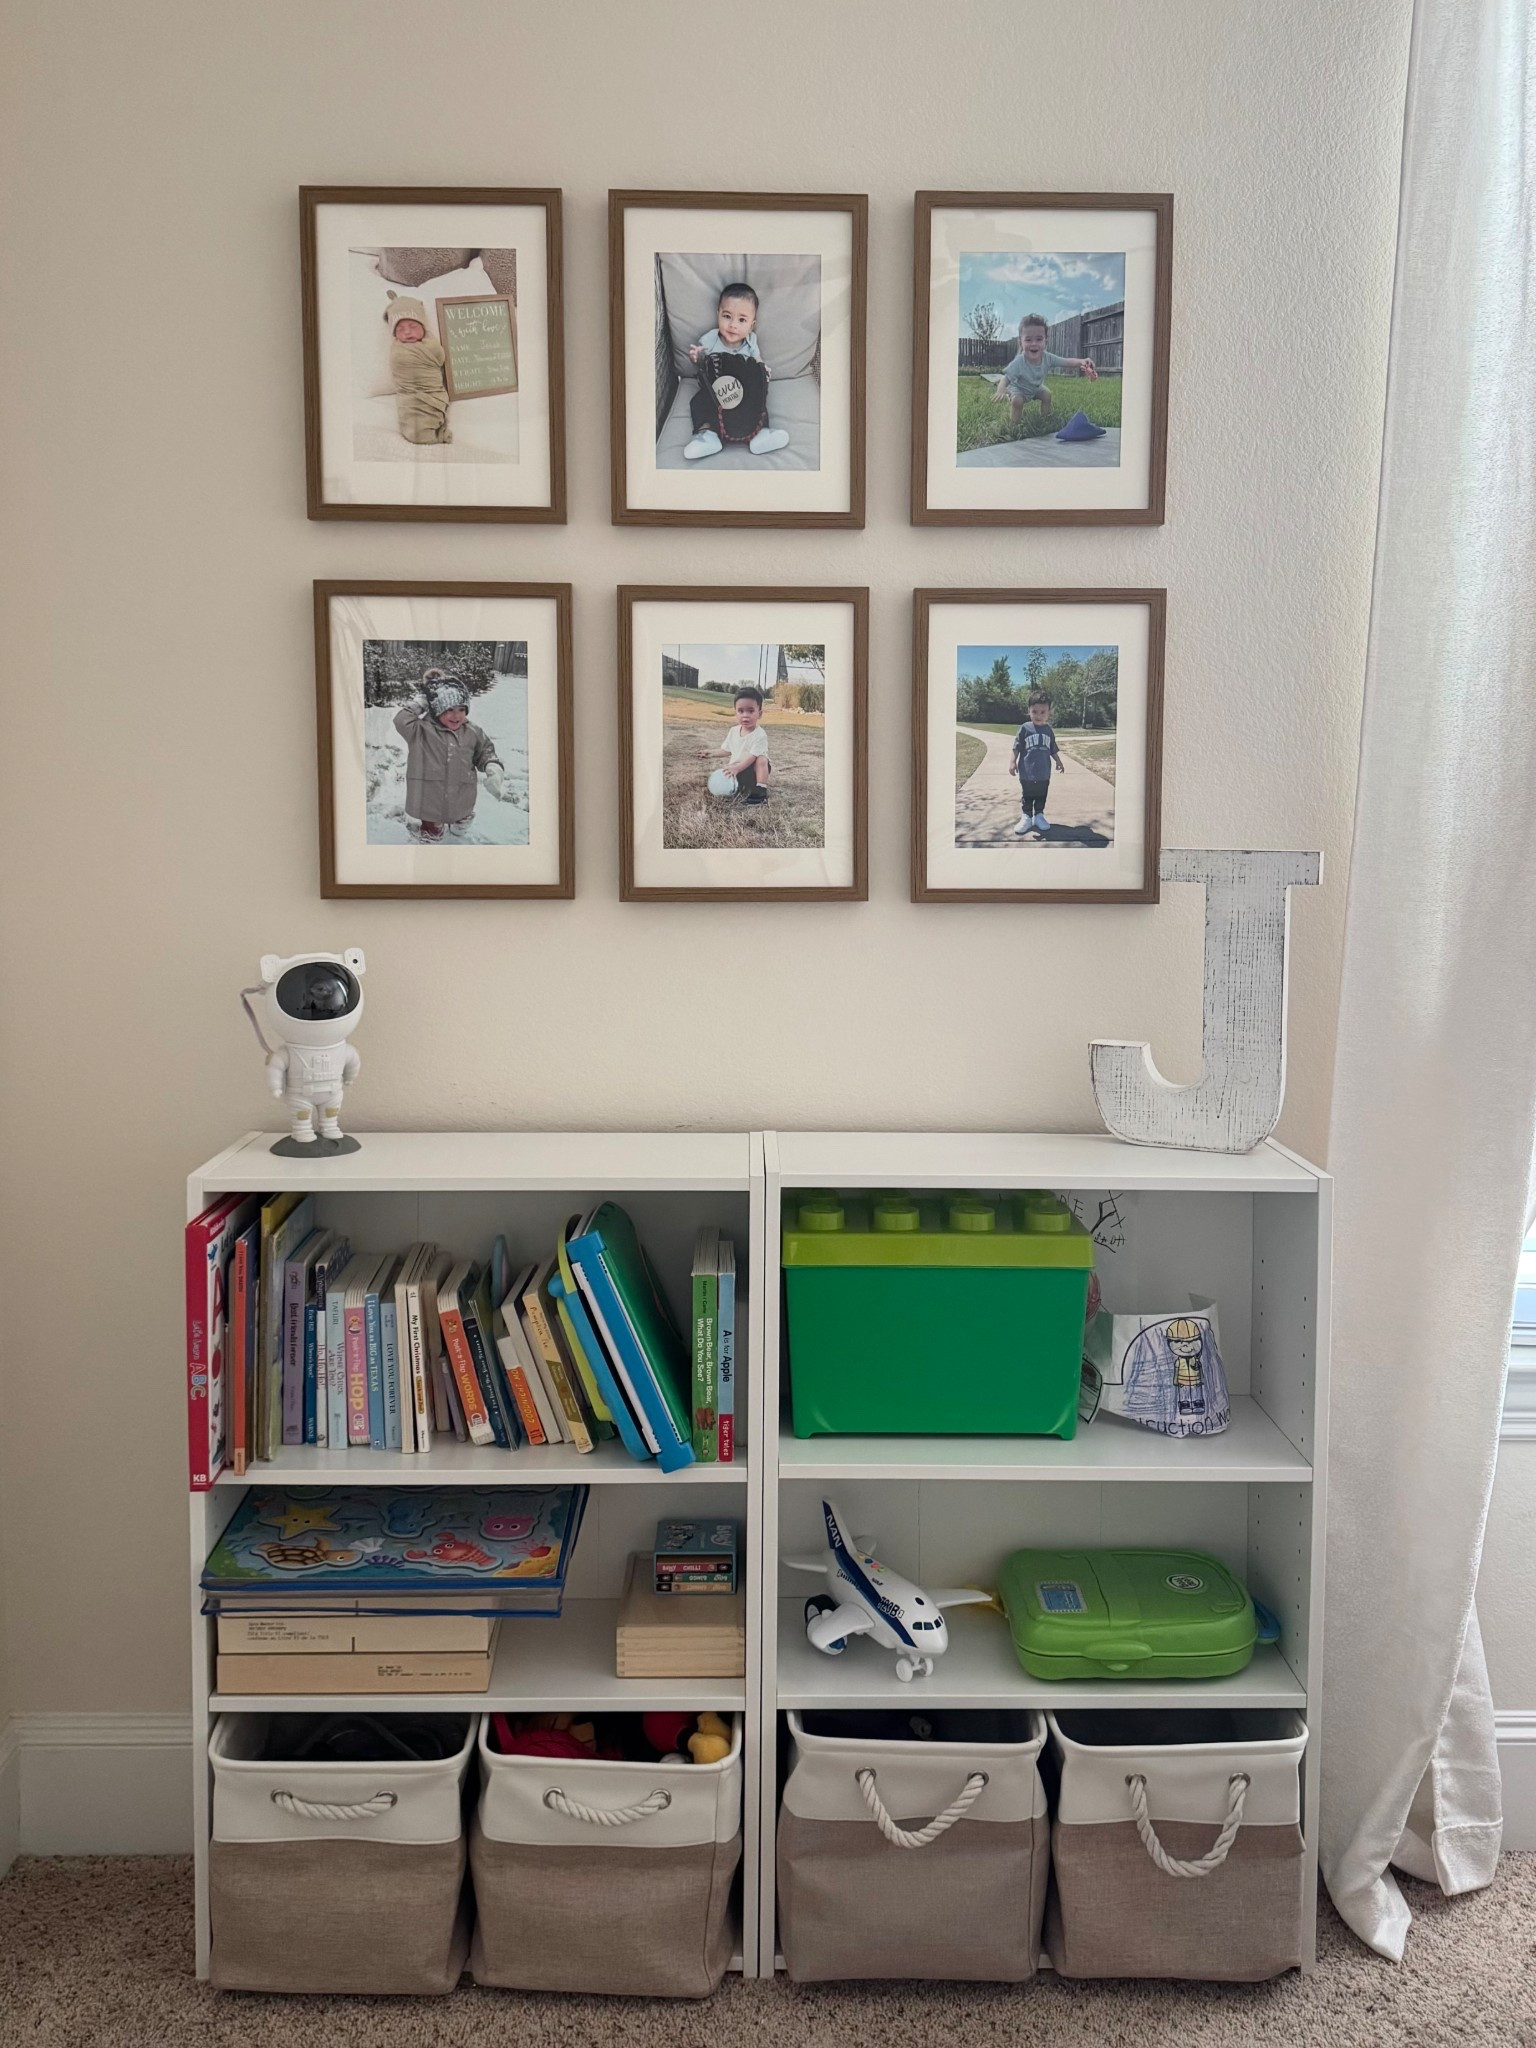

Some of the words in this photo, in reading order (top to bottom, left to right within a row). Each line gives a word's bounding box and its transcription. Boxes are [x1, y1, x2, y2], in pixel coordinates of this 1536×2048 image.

[445, 305, 506, 320] WELCOME
[483, 320, 499, 332] love
[717, 379, 741, 397] even
[367, 1304, 375, 1320] Love
[411, 1315, 419, 1326] My
[412, 1327, 420, 1341] First
[696, 1337, 703, 1348] Do
[386, 1344, 394, 1362] LOVE
[413, 1342, 422, 1374] Christmas
[387, 1364, 395, 1380] YOU
[511, 1368, 520, 1381] MO
[720, 1355, 731, 1382] Apple
[370, 1366, 378, 1392] TEXAS
[350, 1373, 364, 1410] HOP
[388, 1382, 396, 1415] FOREVER
[461, 1374, 476, 1410] WORDS
[515, 1382, 534, 1424] GOODNIGHT
[721, 1420, 729, 1437] tiger
[193, 1474, 207, 1483] KB
[826, 1514, 842, 1548] NAN
